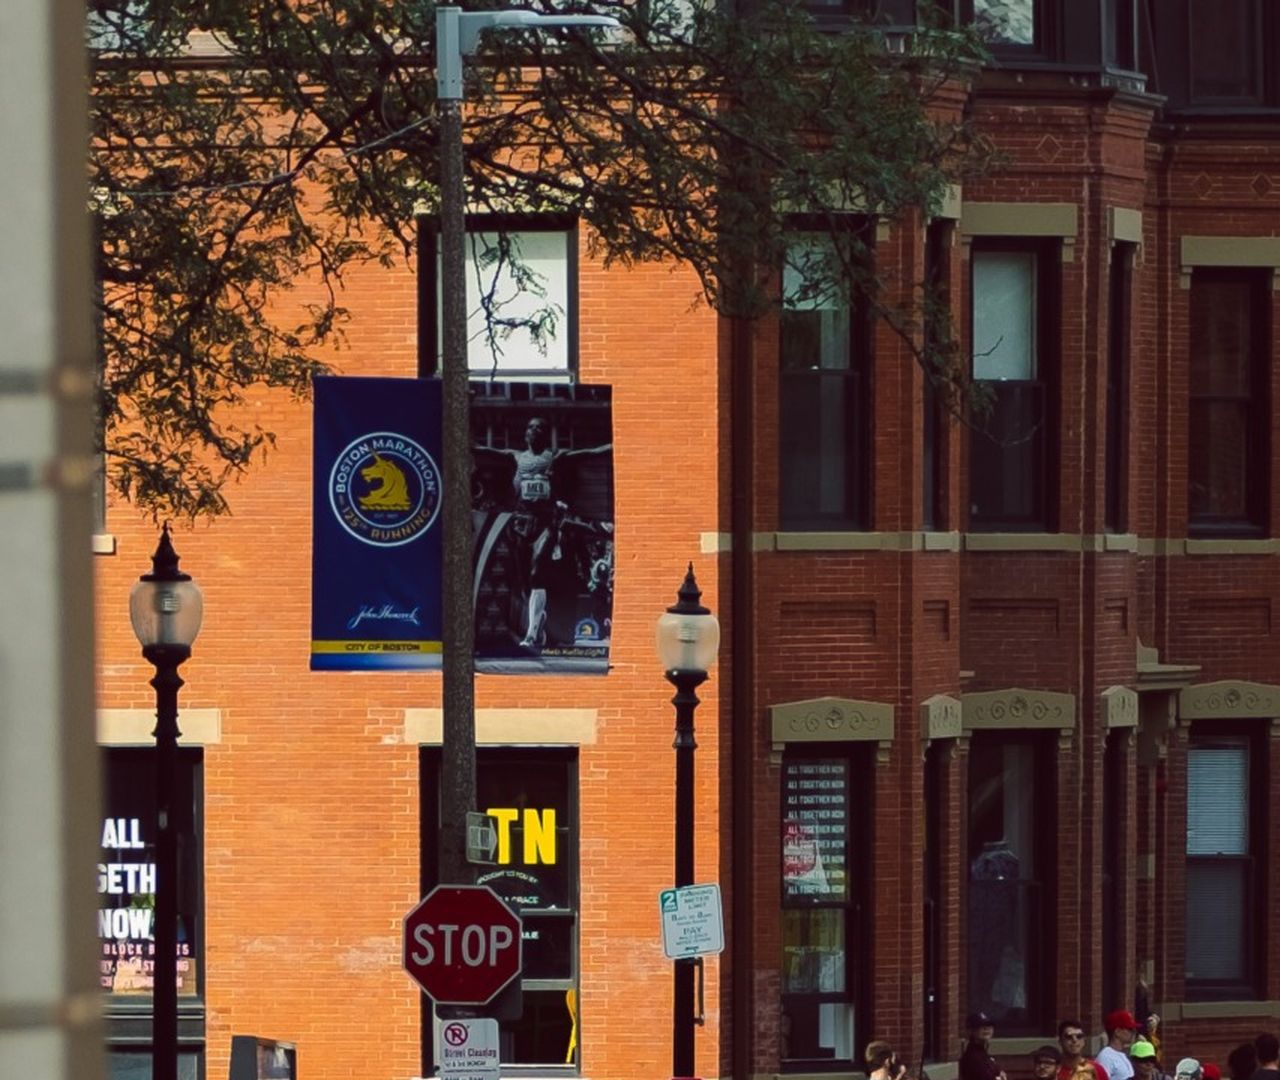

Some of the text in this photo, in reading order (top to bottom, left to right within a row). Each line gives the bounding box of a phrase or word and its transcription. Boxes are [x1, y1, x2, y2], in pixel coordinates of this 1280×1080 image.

[336, 439, 436, 493] BOSTON MARATHON
[371, 508, 430, 540] RUNNING
[345, 643, 420, 651] CITY OF BOSTON
[101, 818, 145, 849] ALL
[663, 892, 675, 906] 2
[411, 923, 514, 967] STOP
